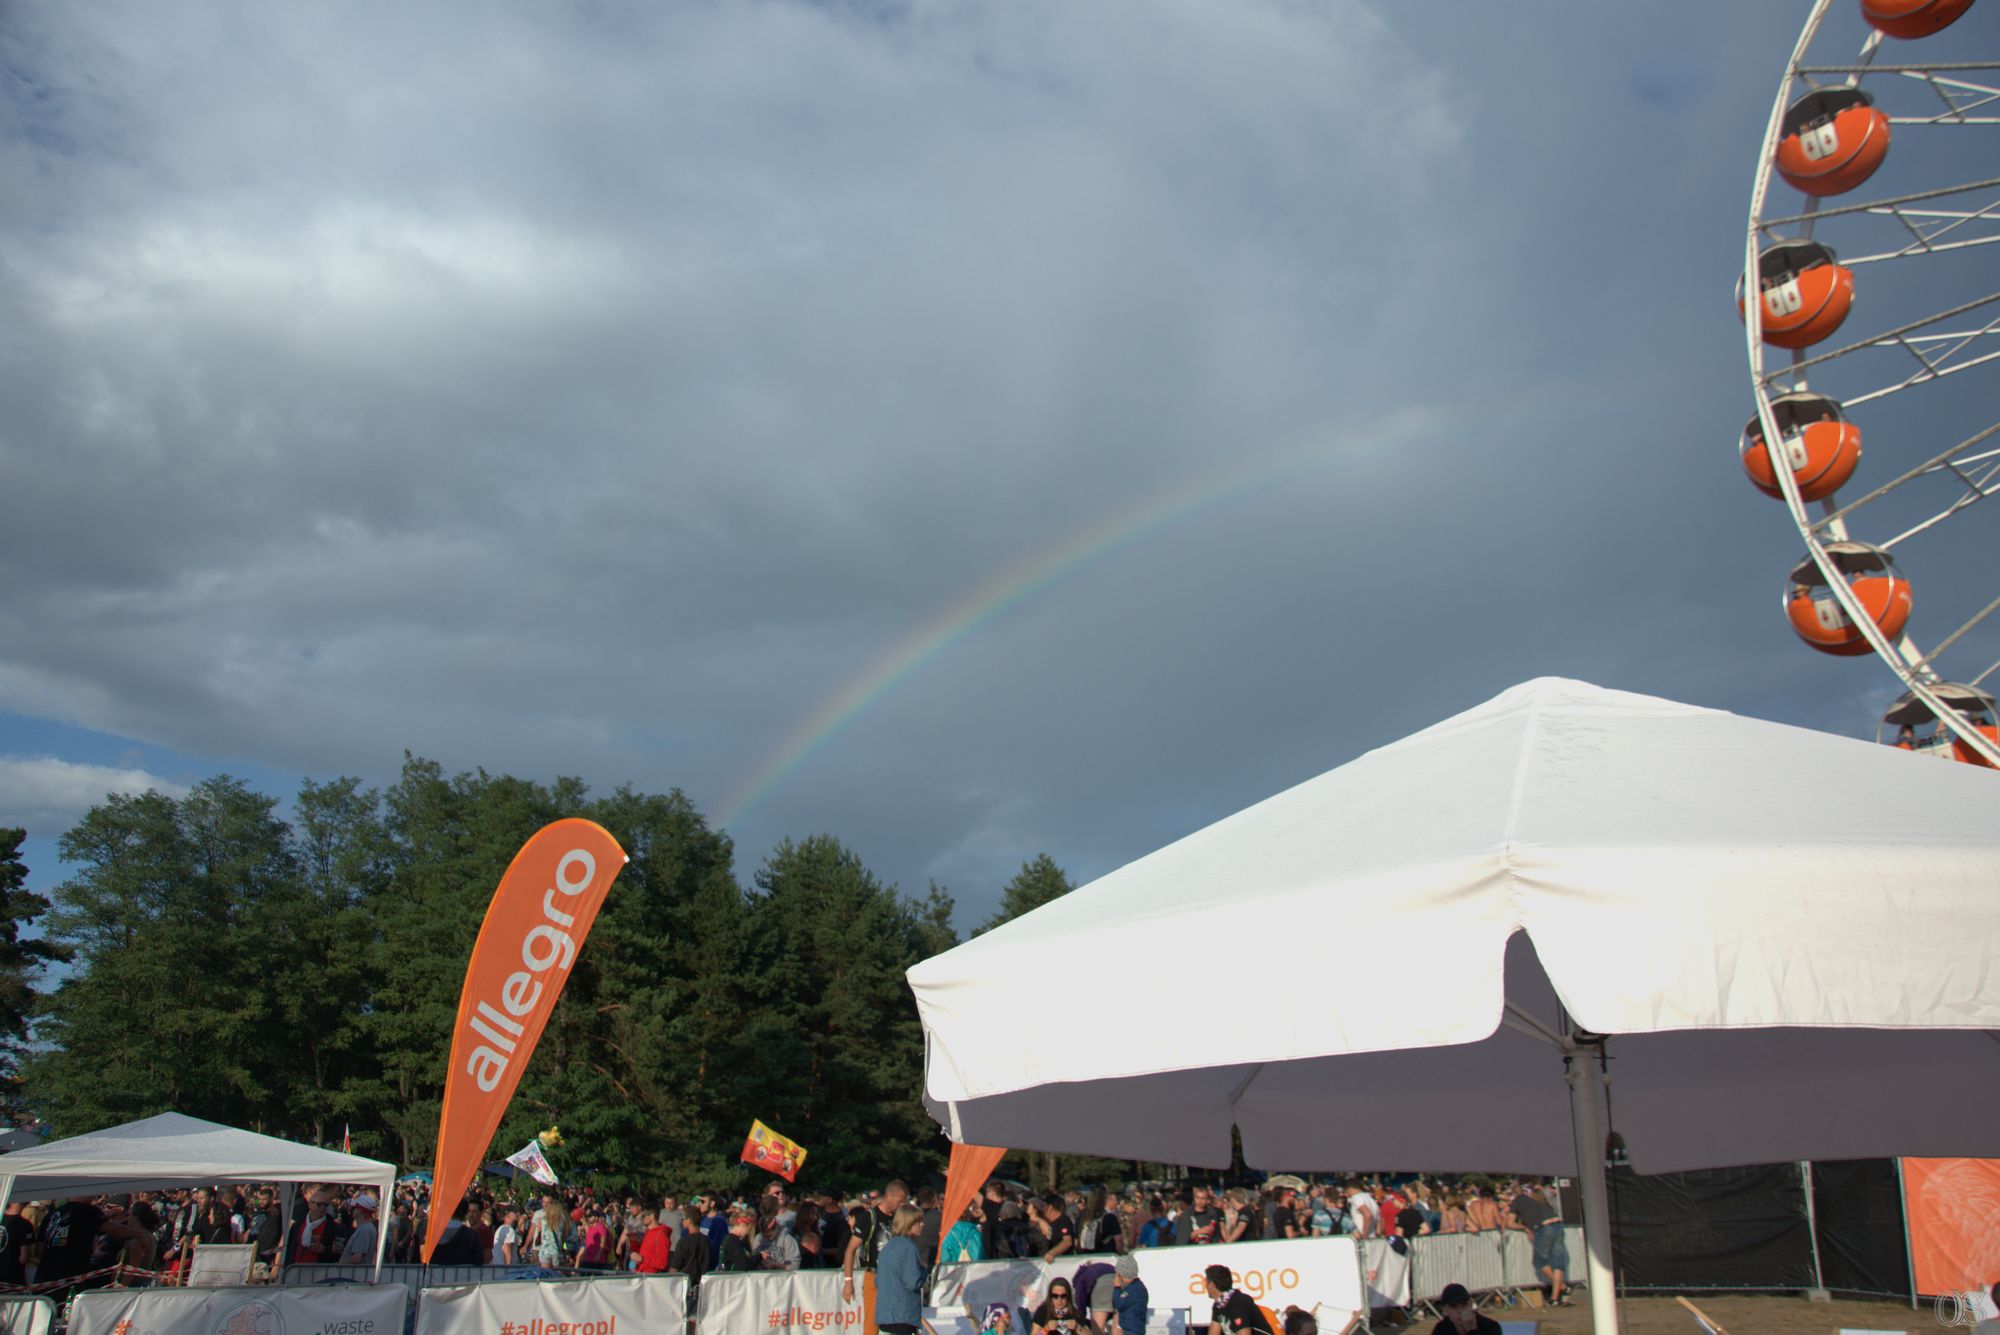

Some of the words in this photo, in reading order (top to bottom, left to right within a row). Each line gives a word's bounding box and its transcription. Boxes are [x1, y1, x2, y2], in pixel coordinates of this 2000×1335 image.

[467, 849, 595, 1092] allegro
[1189, 1268, 1299, 1300] aegro
[324, 1319, 374, 1335] waste
[500, 1315, 616, 1335] #allegropl
[767, 1306, 862, 1330] #allegropl
